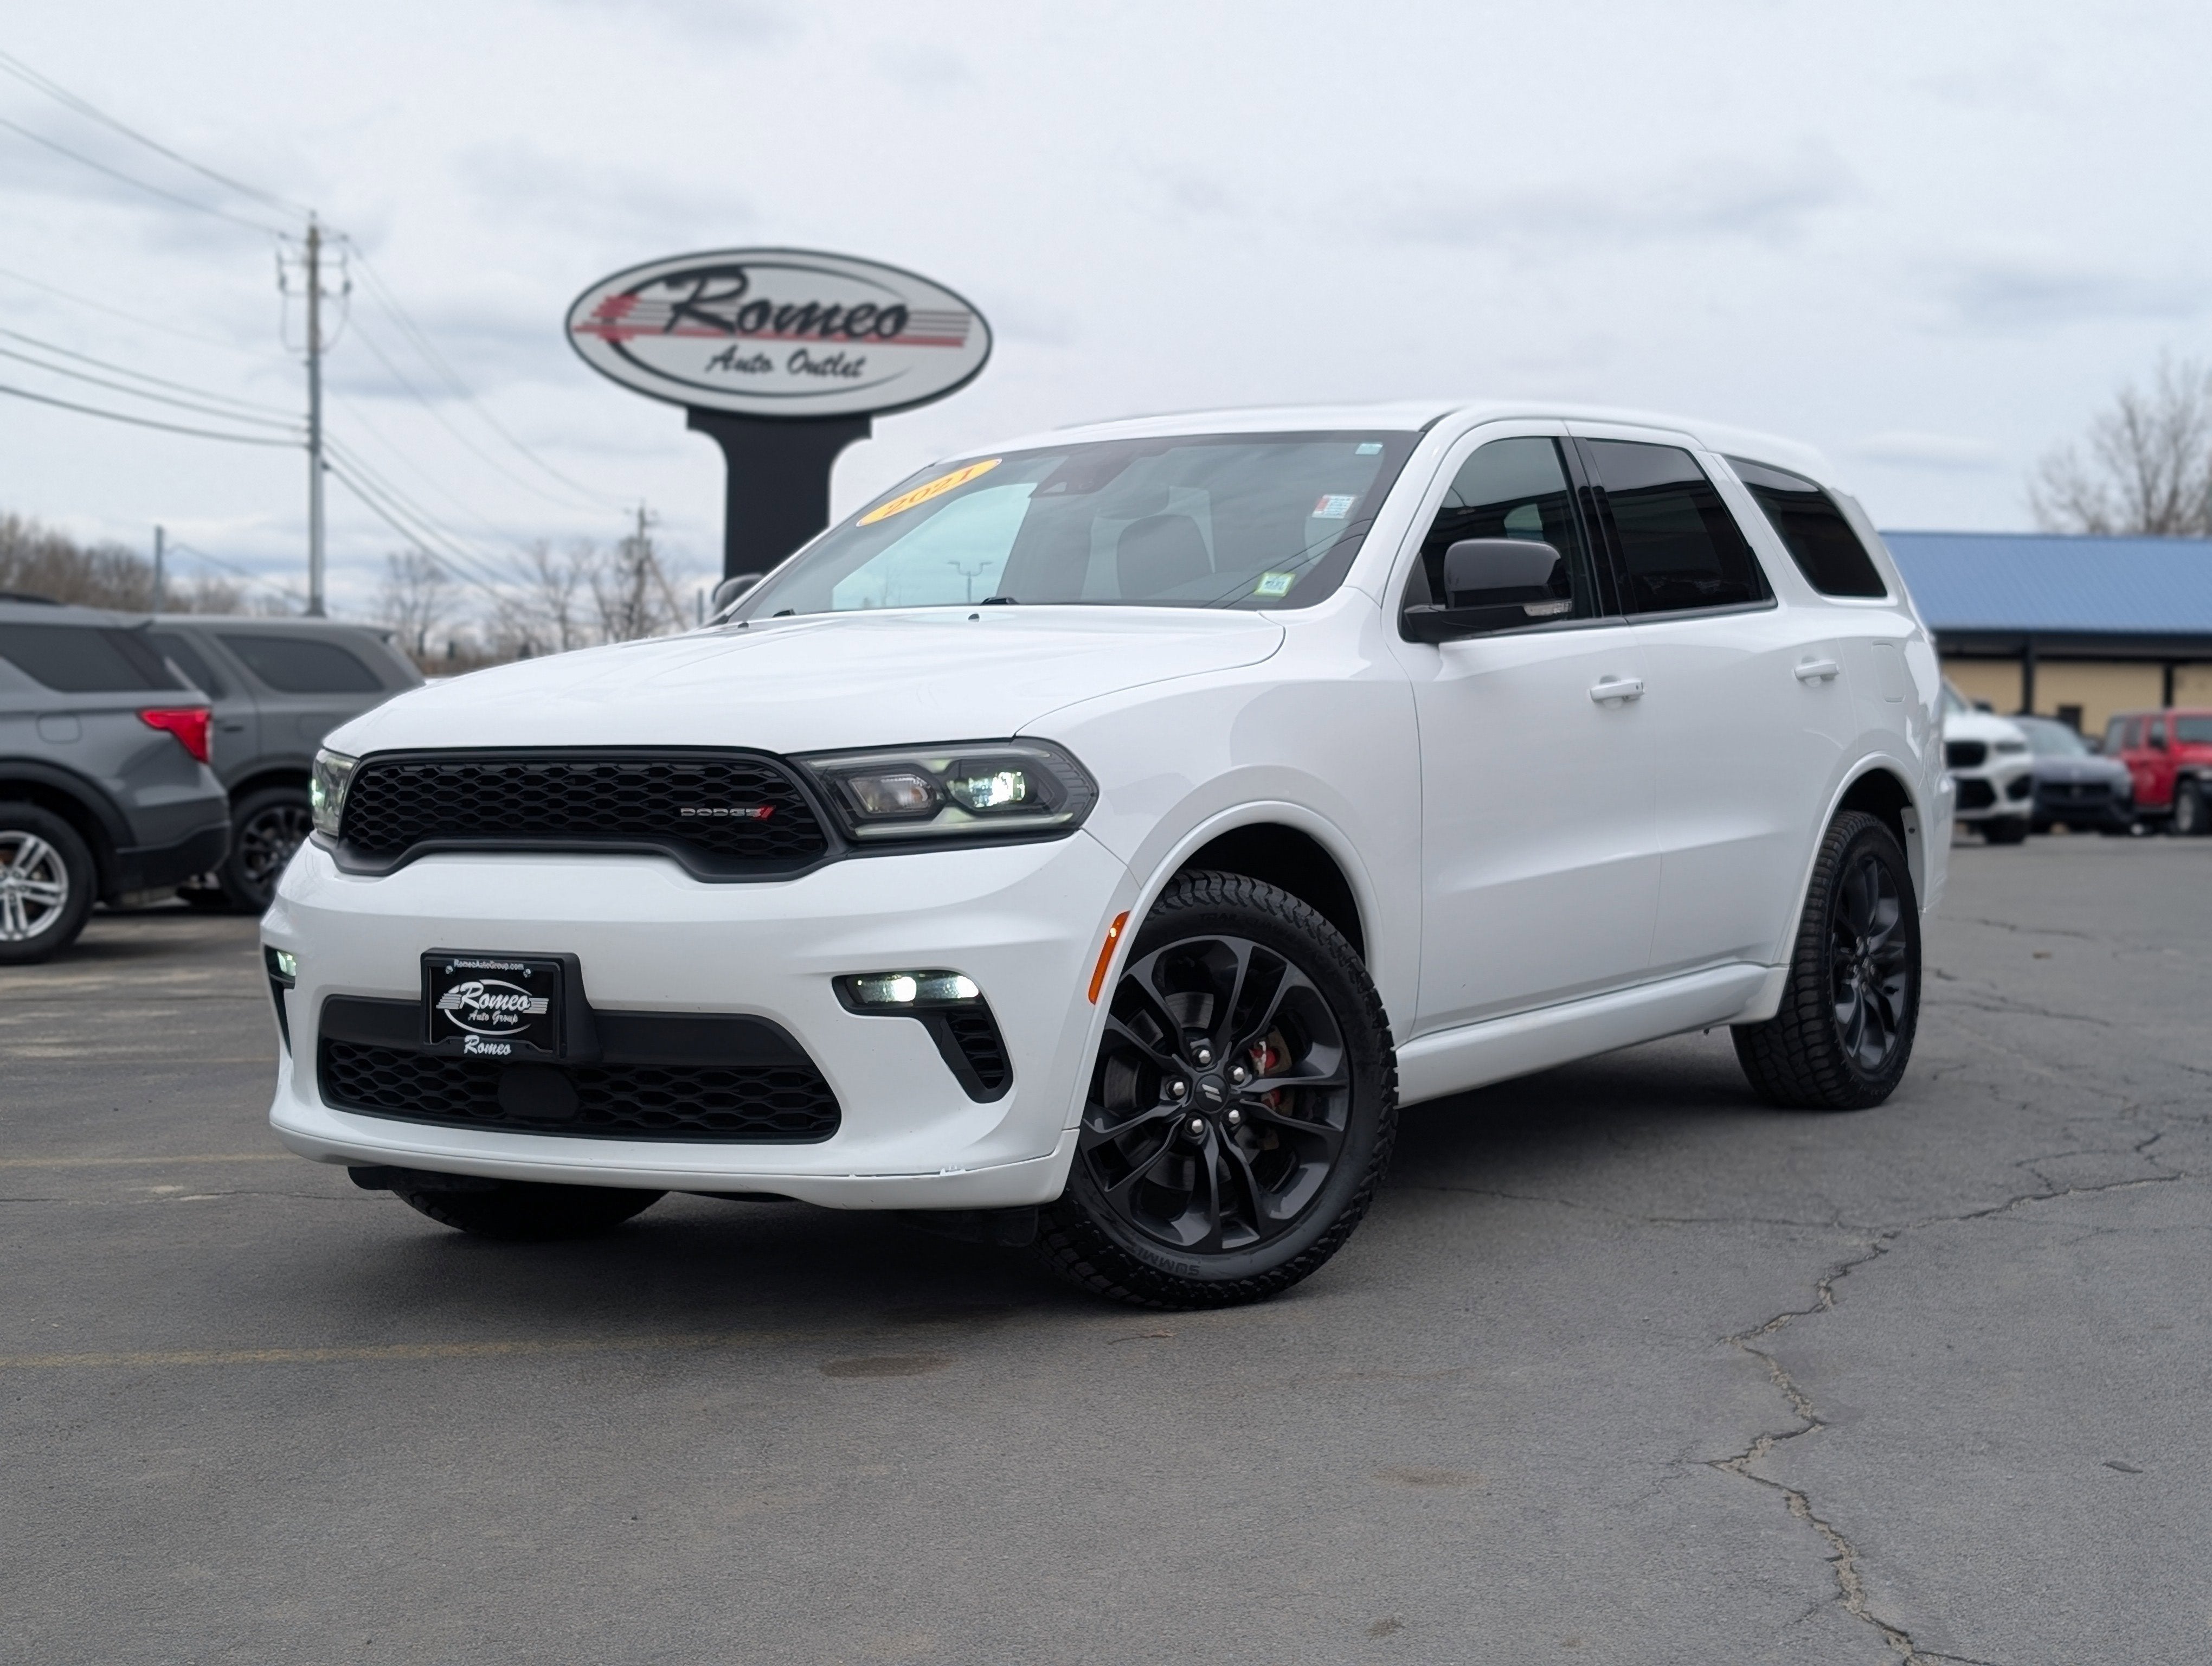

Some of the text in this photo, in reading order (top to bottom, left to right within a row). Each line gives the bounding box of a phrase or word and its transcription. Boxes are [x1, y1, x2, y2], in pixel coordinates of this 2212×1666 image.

[663, 265, 909, 338] Romeo
[706, 344, 866, 377] Auto Outlet
[883, 467, 974, 516] 2021
[680, 808, 761, 817] DODGE
[454, 959, 524, 970] RomeoAutoGroup.com
[460, 982, 531, 1011] Romeo
[468, 1010, 518, 1024] Auto Group
[464, 1035, 511, 1055] Romeo
